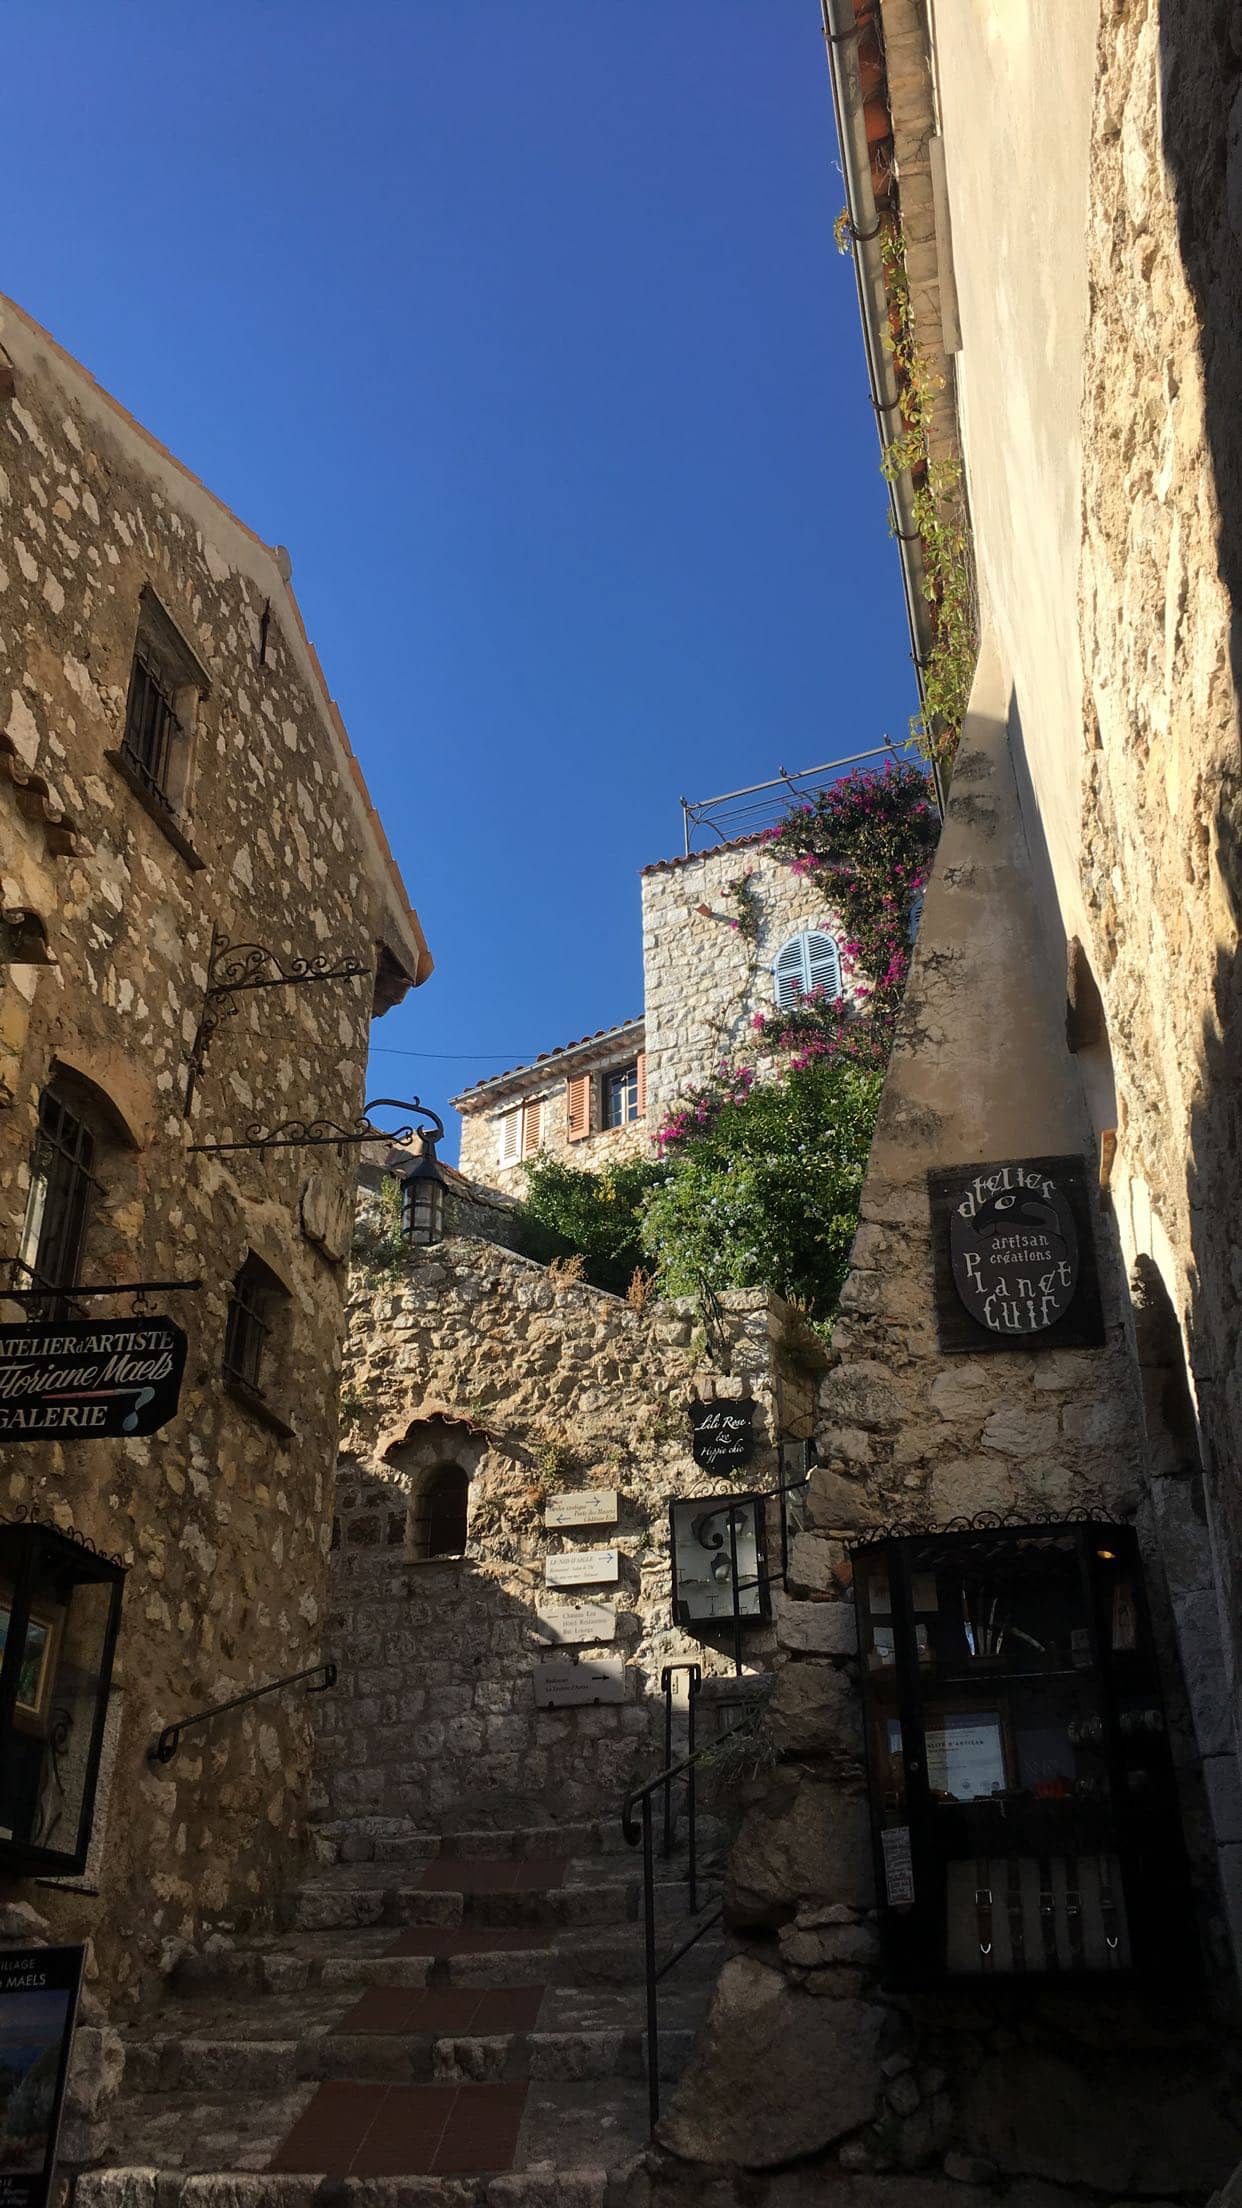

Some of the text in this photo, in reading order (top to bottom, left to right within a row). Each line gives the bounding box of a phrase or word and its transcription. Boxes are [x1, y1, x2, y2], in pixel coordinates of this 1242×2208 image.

[992, 1234, 1050, 1249] artisan
[964, 1253, 1072, 1298] Planet
[694, 1413, 747, 1431] Lili Rose
[0, 1958, 38, 1971] ILLAGE
[6, 1973, 46, 1988] MAELS
